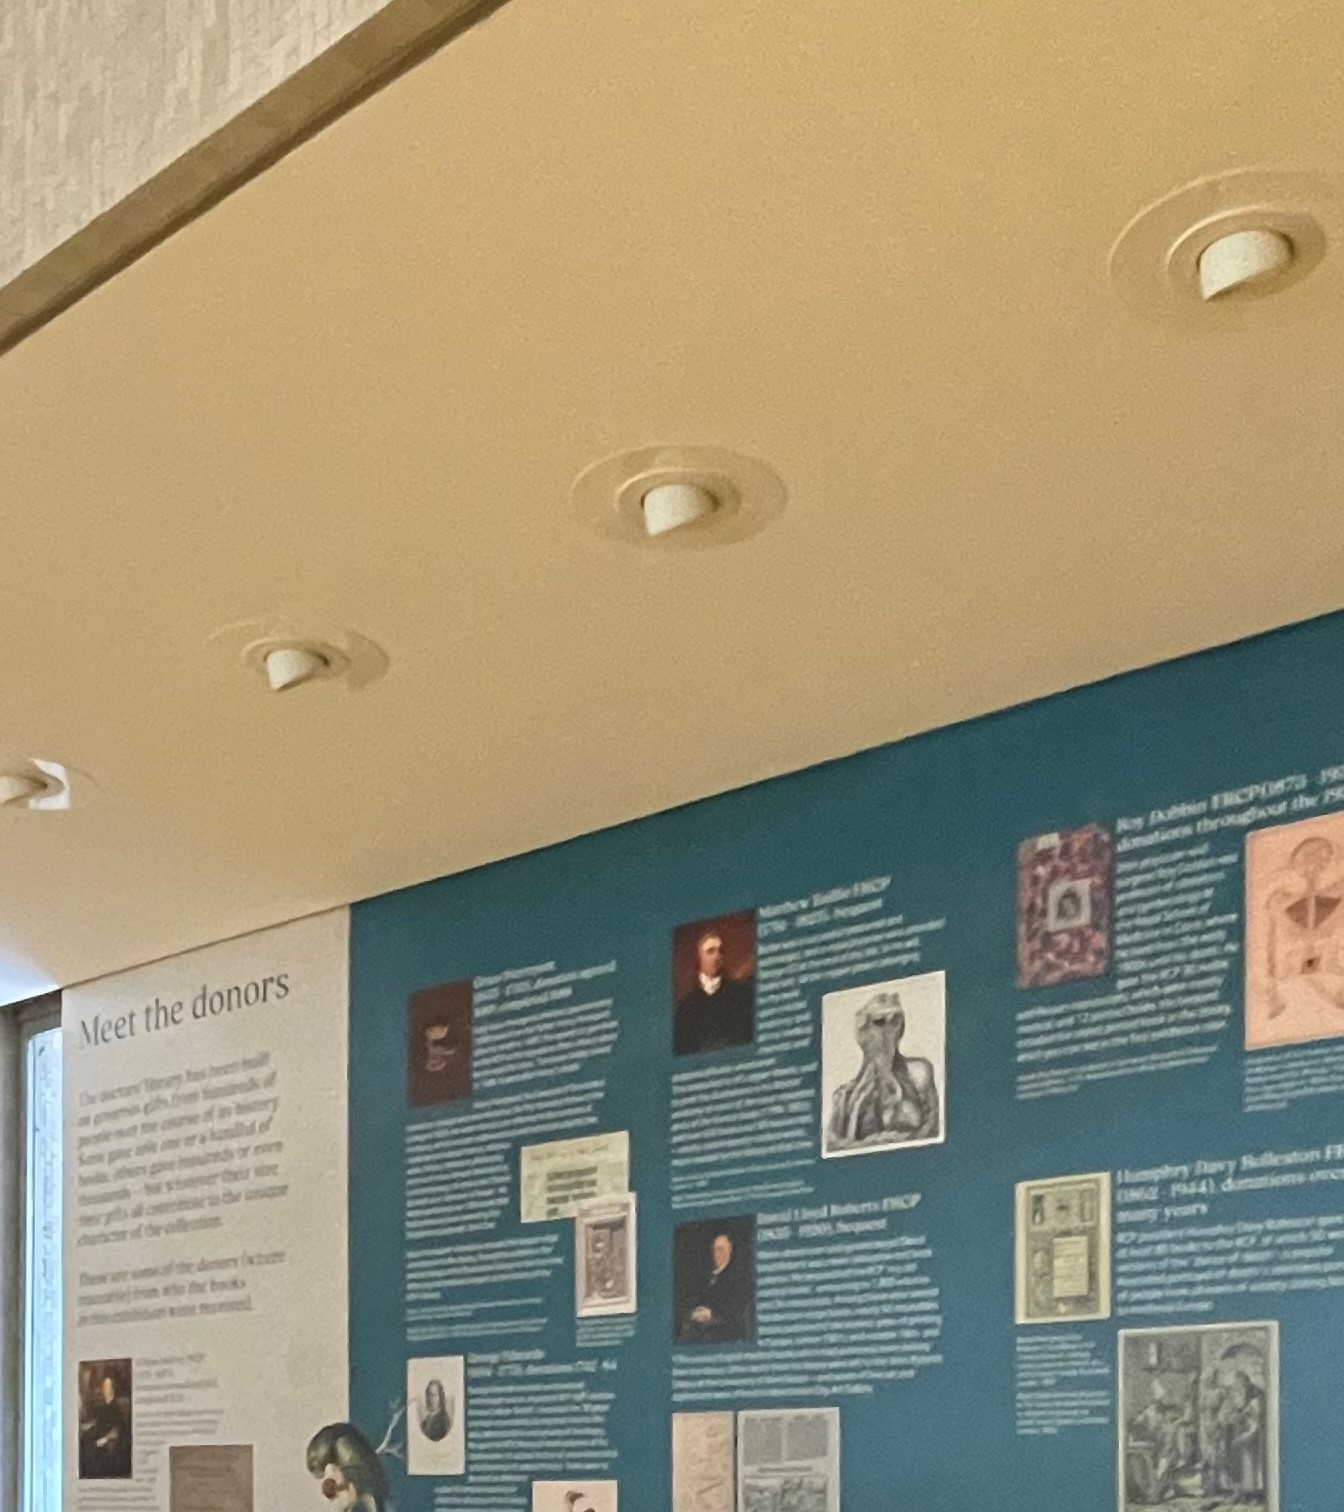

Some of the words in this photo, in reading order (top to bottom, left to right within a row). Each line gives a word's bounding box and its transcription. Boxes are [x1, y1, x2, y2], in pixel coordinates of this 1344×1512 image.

[1196, 800, 1288, 834] throughout
[1291, 792, 1320, 813] the
[80, 1009, 137, 1047] Meet
[144, 997, 184, 1033] the
[192, 972, 291, 1020] donors
[1163, 1202, 1209, 1222] years
